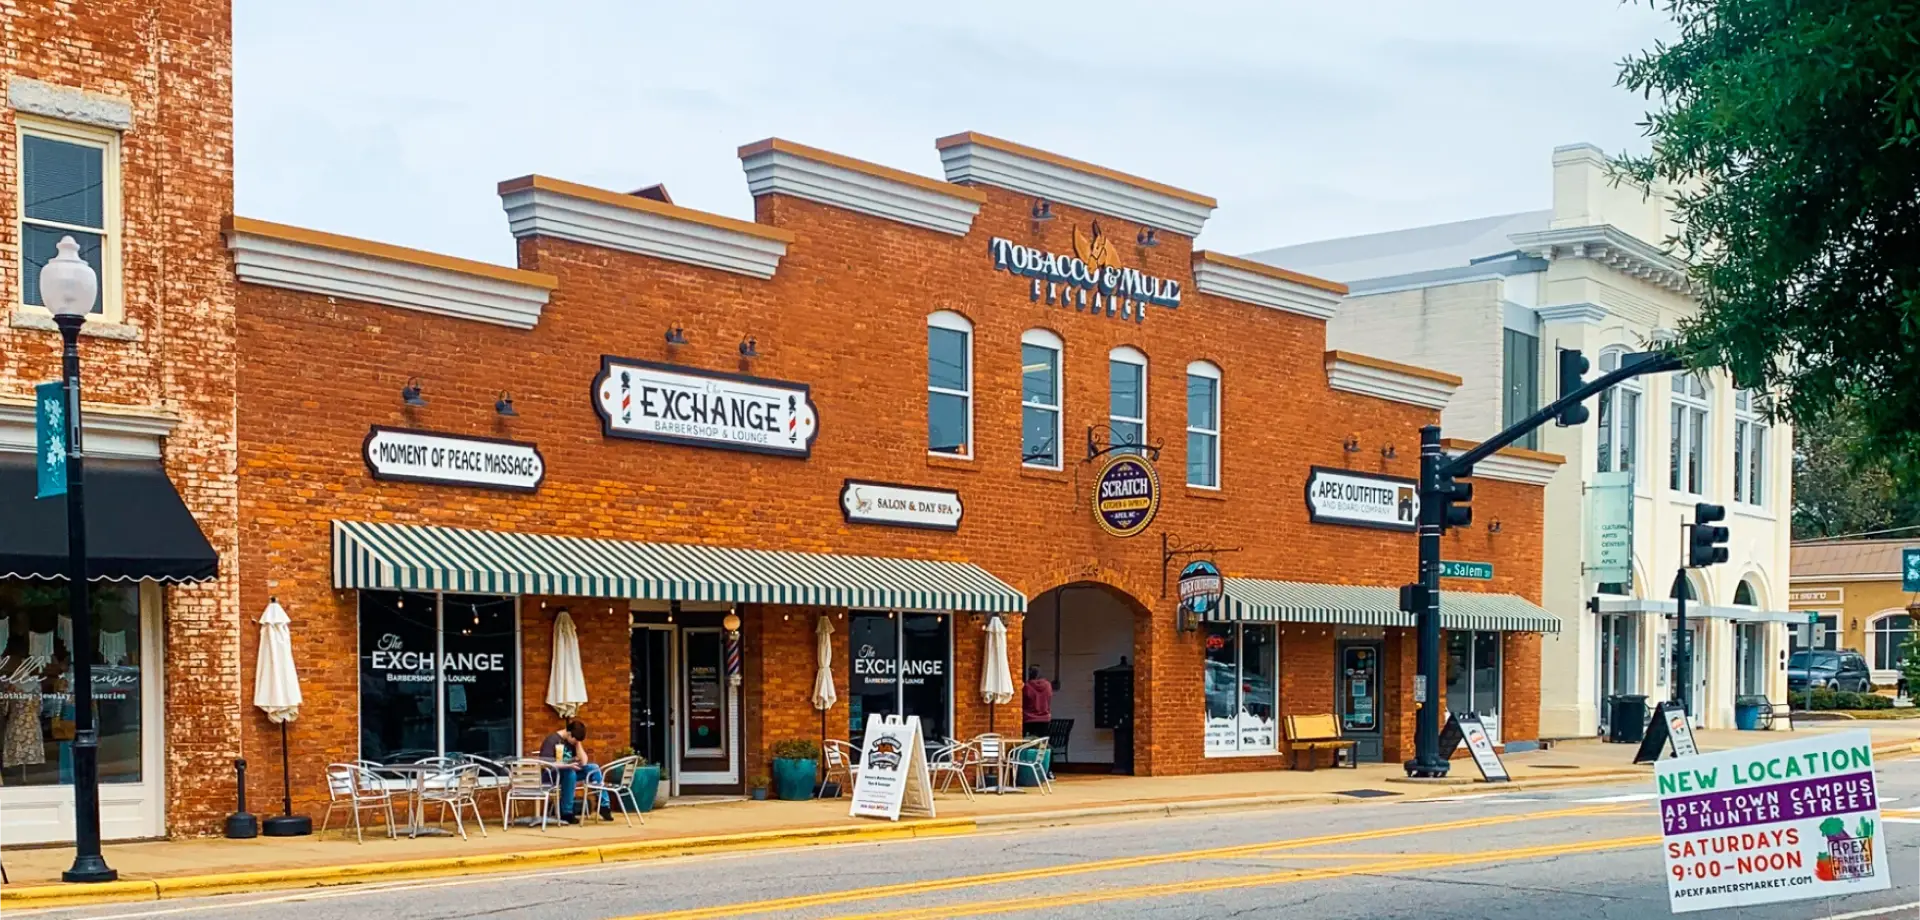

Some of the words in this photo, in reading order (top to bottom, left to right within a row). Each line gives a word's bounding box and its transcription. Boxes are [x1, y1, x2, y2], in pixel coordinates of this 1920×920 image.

[991, 236, 1100, 285] TOBACCO
[1104, 266, 1121, 288] &
[1120, 267, 1181, 301] MULE
[1033, 279, 1146, 318] EXCHANGE
[641, 386, 781, 433] EXCHANGE
[655, 421, 718, 438] BARBERSHOP
[732, 431, 768, 443] LOUNGE
[380, 441, 428, 467] MOMENT
[431, 448, 444, 467] OF
[448, 450, 482, 472] PEACE
[485, 453, 534, 477] MASSAGE
[1102, 478, 1148, 498] SCRATCH
[1319, 481, 1344, 500] APEX
[1346, 485, 1394, 506] OUTFITTER
[878, 498, 906, 510] SALON
[909, 501, 916, 511] &
[918, 502, 936, 513] DAY
[937, 504, 953, 515] SPA
[1322, 501, 1336, 509] AND
[1454, 564, 1483, 577] Salem
[377, 633, 403, 651] The
[858, 644, 876, 658] The
[372, 651, 504, 671] EXCHANGE
[855, 659, 943, 675] EXCHANGE
[448, 674, 477, 683] LOUNGE
[0, 692, 32, 701] lothing
[1659, 767, 1718, 795] NEW
[1732, 745, 1872, 785] LOCATION
[1665, 800, 1712, 818] APEX
[1723, 791, 1779, 809] TOWN
[1790, 779, 1871, 801] CAMPUS
[1665, 816, 1688, 832] 73
[1700, 806, 1781, 828] HUNTER
[1794, 793, 1873, 816] STREET
[1668, 828, 1800, 859] SATURDAYS
[1831, 840, 1868, 855] APEX
[1672, 851, 1803, 881] 9:00-NOON
[1832, 853, 1870, 864] FARMERS
[1833, 862, 1871, 875] MARKET
[1674, 876, 1813, 899] APEXFARMERSMARKET.COM
